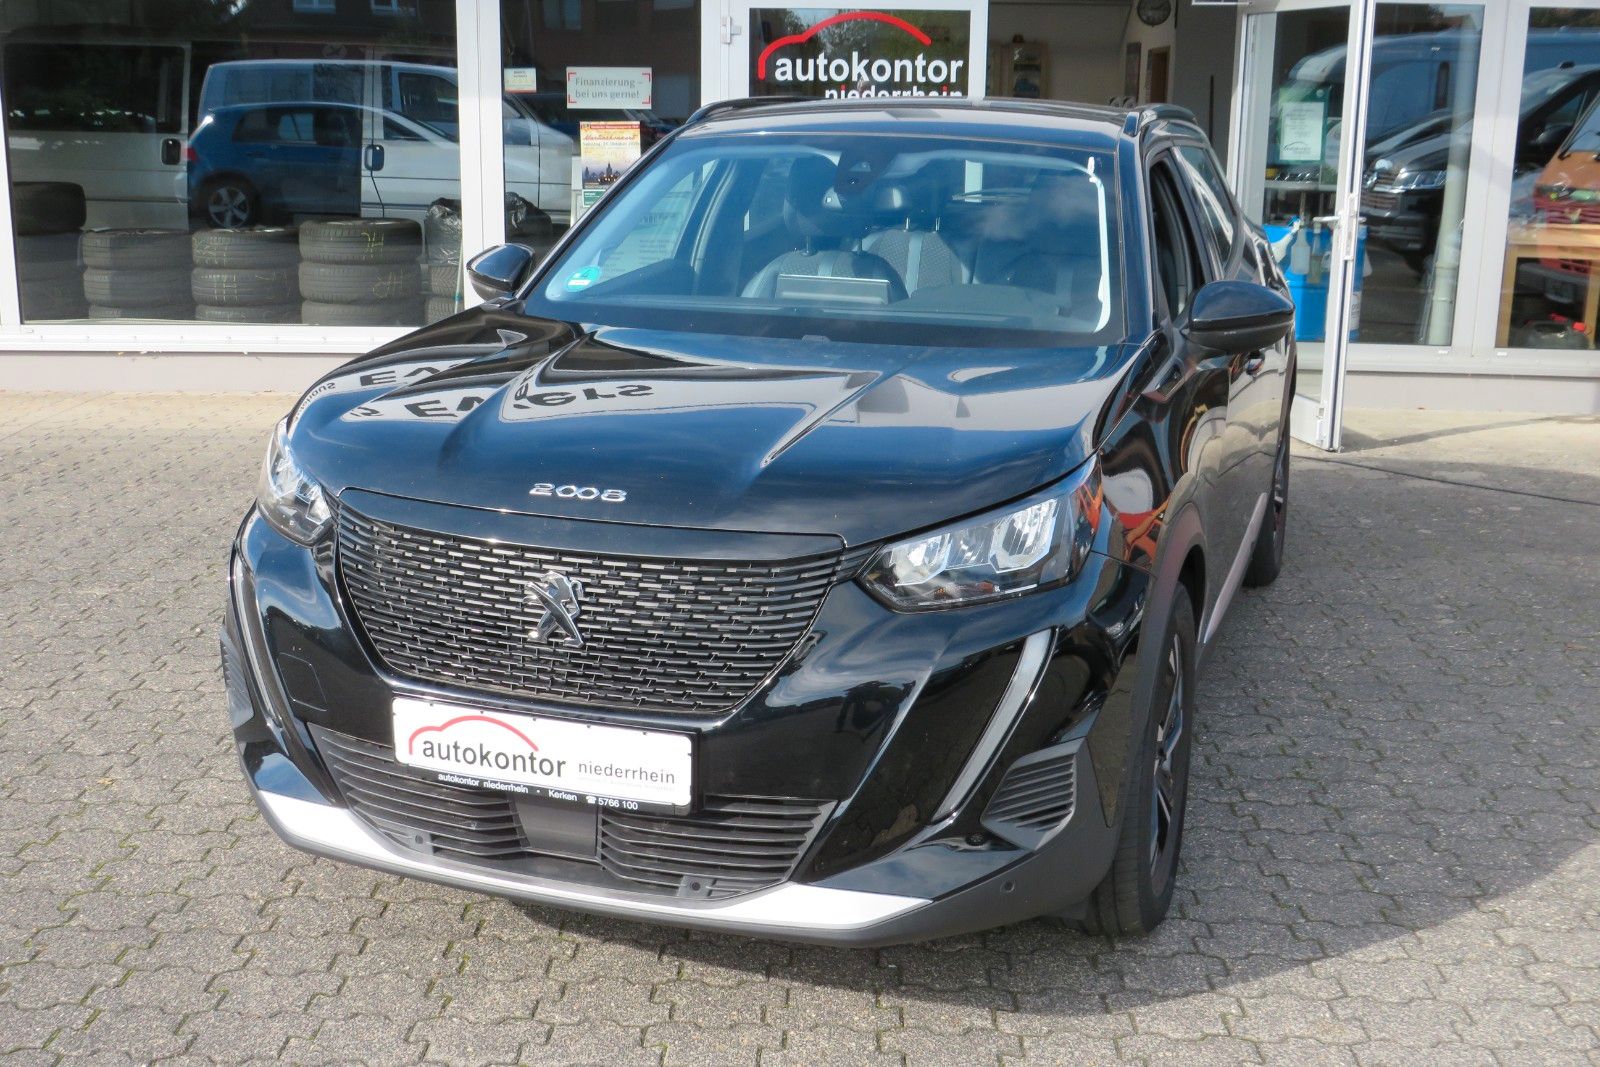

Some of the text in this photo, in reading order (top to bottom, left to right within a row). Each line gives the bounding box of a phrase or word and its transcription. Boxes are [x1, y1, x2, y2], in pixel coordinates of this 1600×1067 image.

[774, 51, 964, 83] autokontor
[575, 77, 635, 88] Finanzierung
[575, 90, 589, 98] bei
[610, 90, 640, 100] gerne!
[528, 482, 628, 502] 2008
[422, 740, 567, 778] autokontor
[578, 761, 675, 785] niederrhein
[438, 773, 638, 811] autokontor niederrhein Kerken 5766 100
